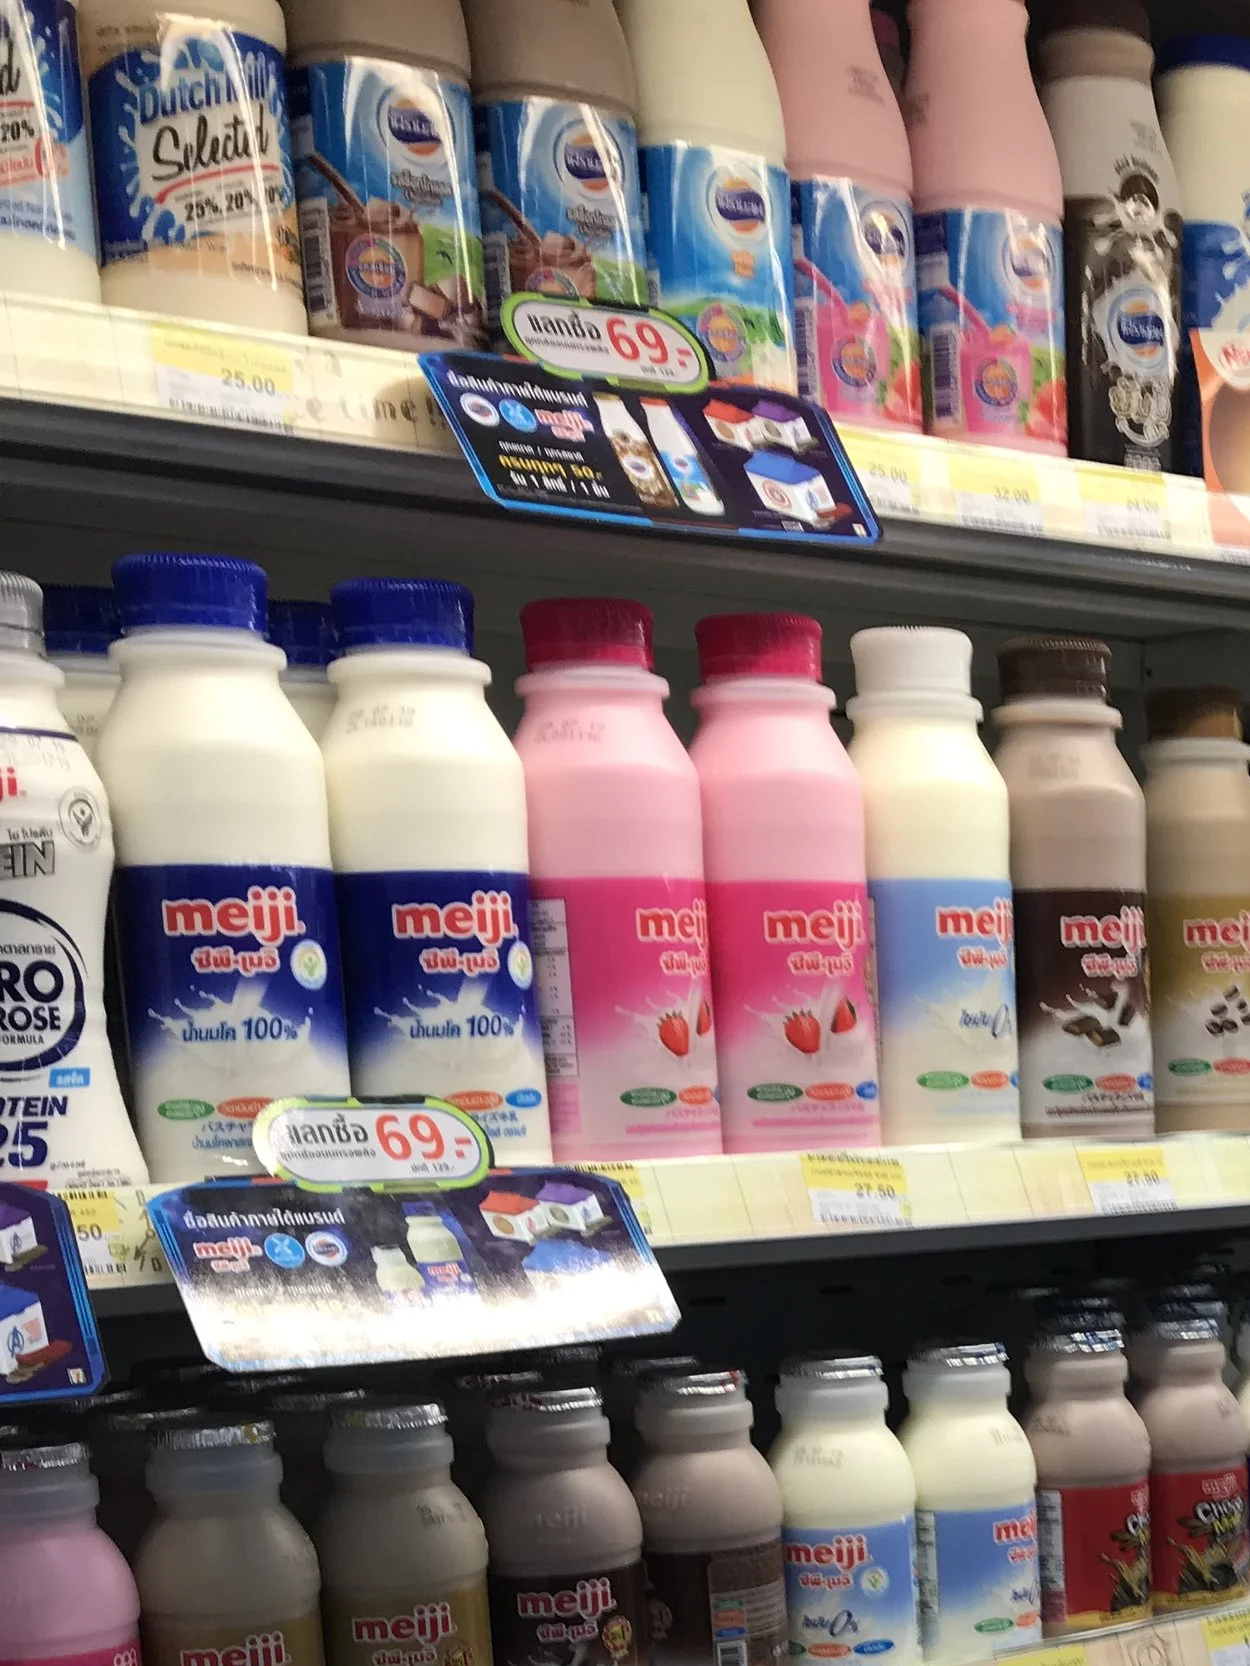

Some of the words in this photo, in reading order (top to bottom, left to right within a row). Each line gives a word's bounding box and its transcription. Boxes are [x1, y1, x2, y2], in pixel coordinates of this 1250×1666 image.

[151, 101, 271, 182] Selected
[525, 310, 603, 344] แลกซื้อ
[221, 367, 277, 394] 25.00
[868, 462, 909, 485] 25.00
[161, 884, 301, 944] meiji
[390, 891, 514, 945] meiji
[763, 900, 864, 951] meiji
[1060, 905, 1147, 952] meiji
[191, 946, 280, 976] ซีพี-เมจิ
[420, 949, 500, 977] ซีพี-เมจิ
[180, 1016, 238, 1043] น้ำนมโค
[242, 1014, 300, 1042] 100%
[409, 1016, 462, 1042] น้ำนมโค
[465, 1013, 516, 1041] 100%
[284, 1112, 370, 1146] แลกซื้อ
[182, 1206, 347, 1231] ซื้อสินค้าภายใต้แบรนด์
[786, 1533, 869, 1569] meiji
[517, 1577, 612, 1622] meiji
[352, 1601, 452, 1646] meiji
